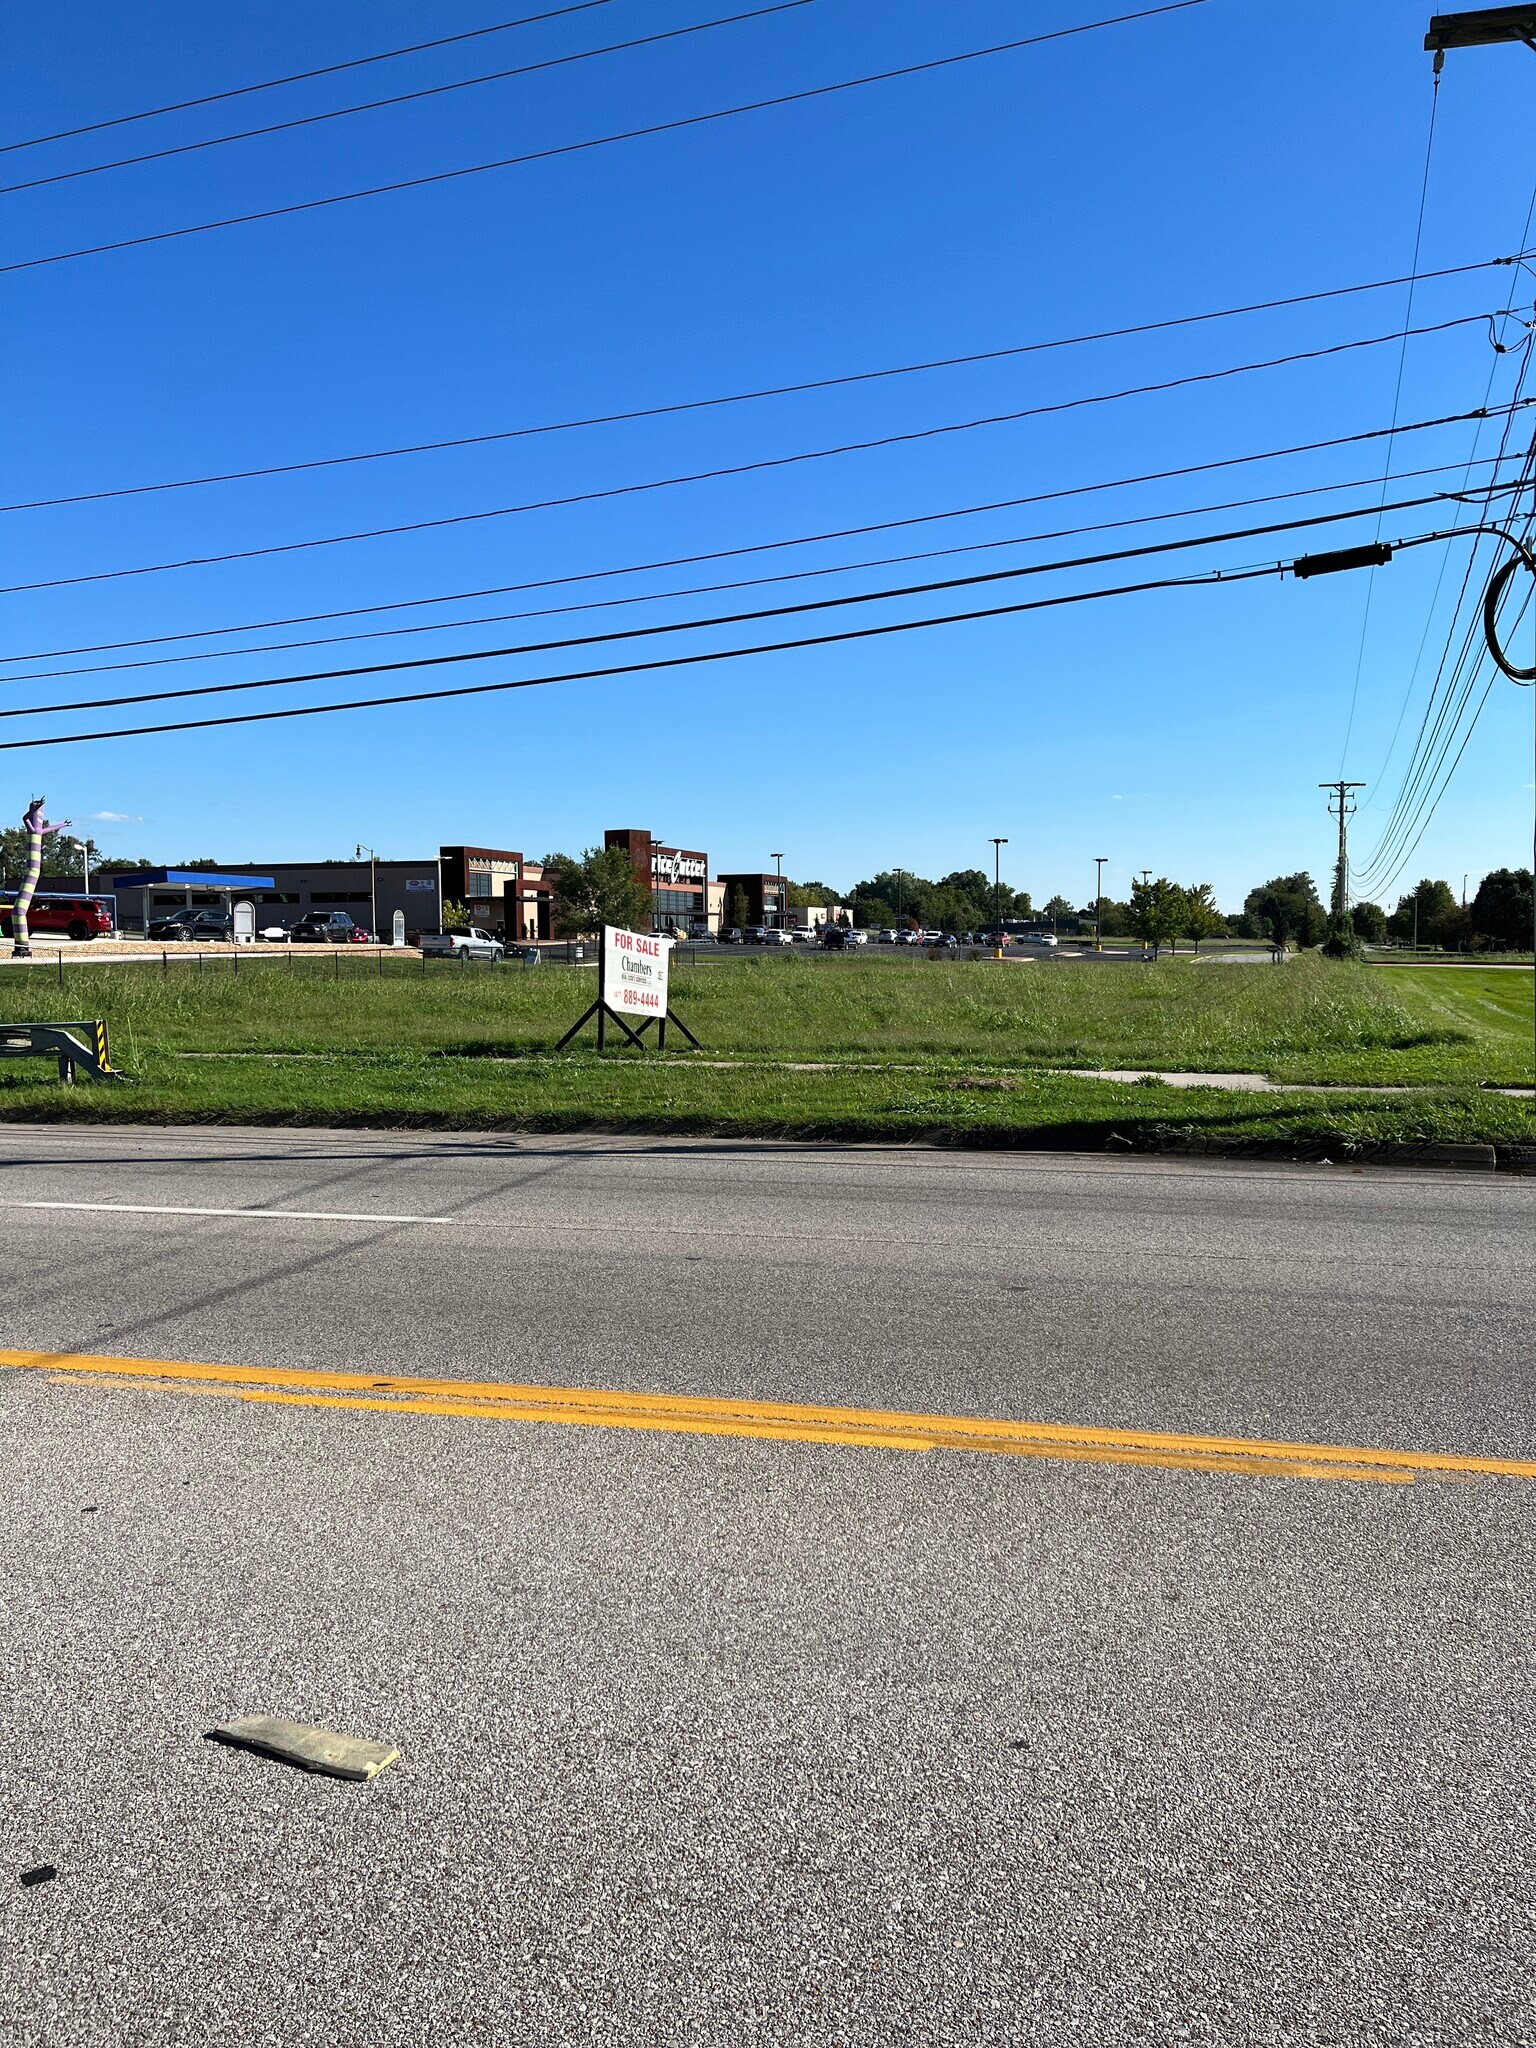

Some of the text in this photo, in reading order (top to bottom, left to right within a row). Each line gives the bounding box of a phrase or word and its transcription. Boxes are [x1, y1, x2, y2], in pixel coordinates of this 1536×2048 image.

[615, 932, 660, 957] FOR SALE
[621, 955, 652, 976] Chambers
[623, 989, 659, 1008] 889-4444
